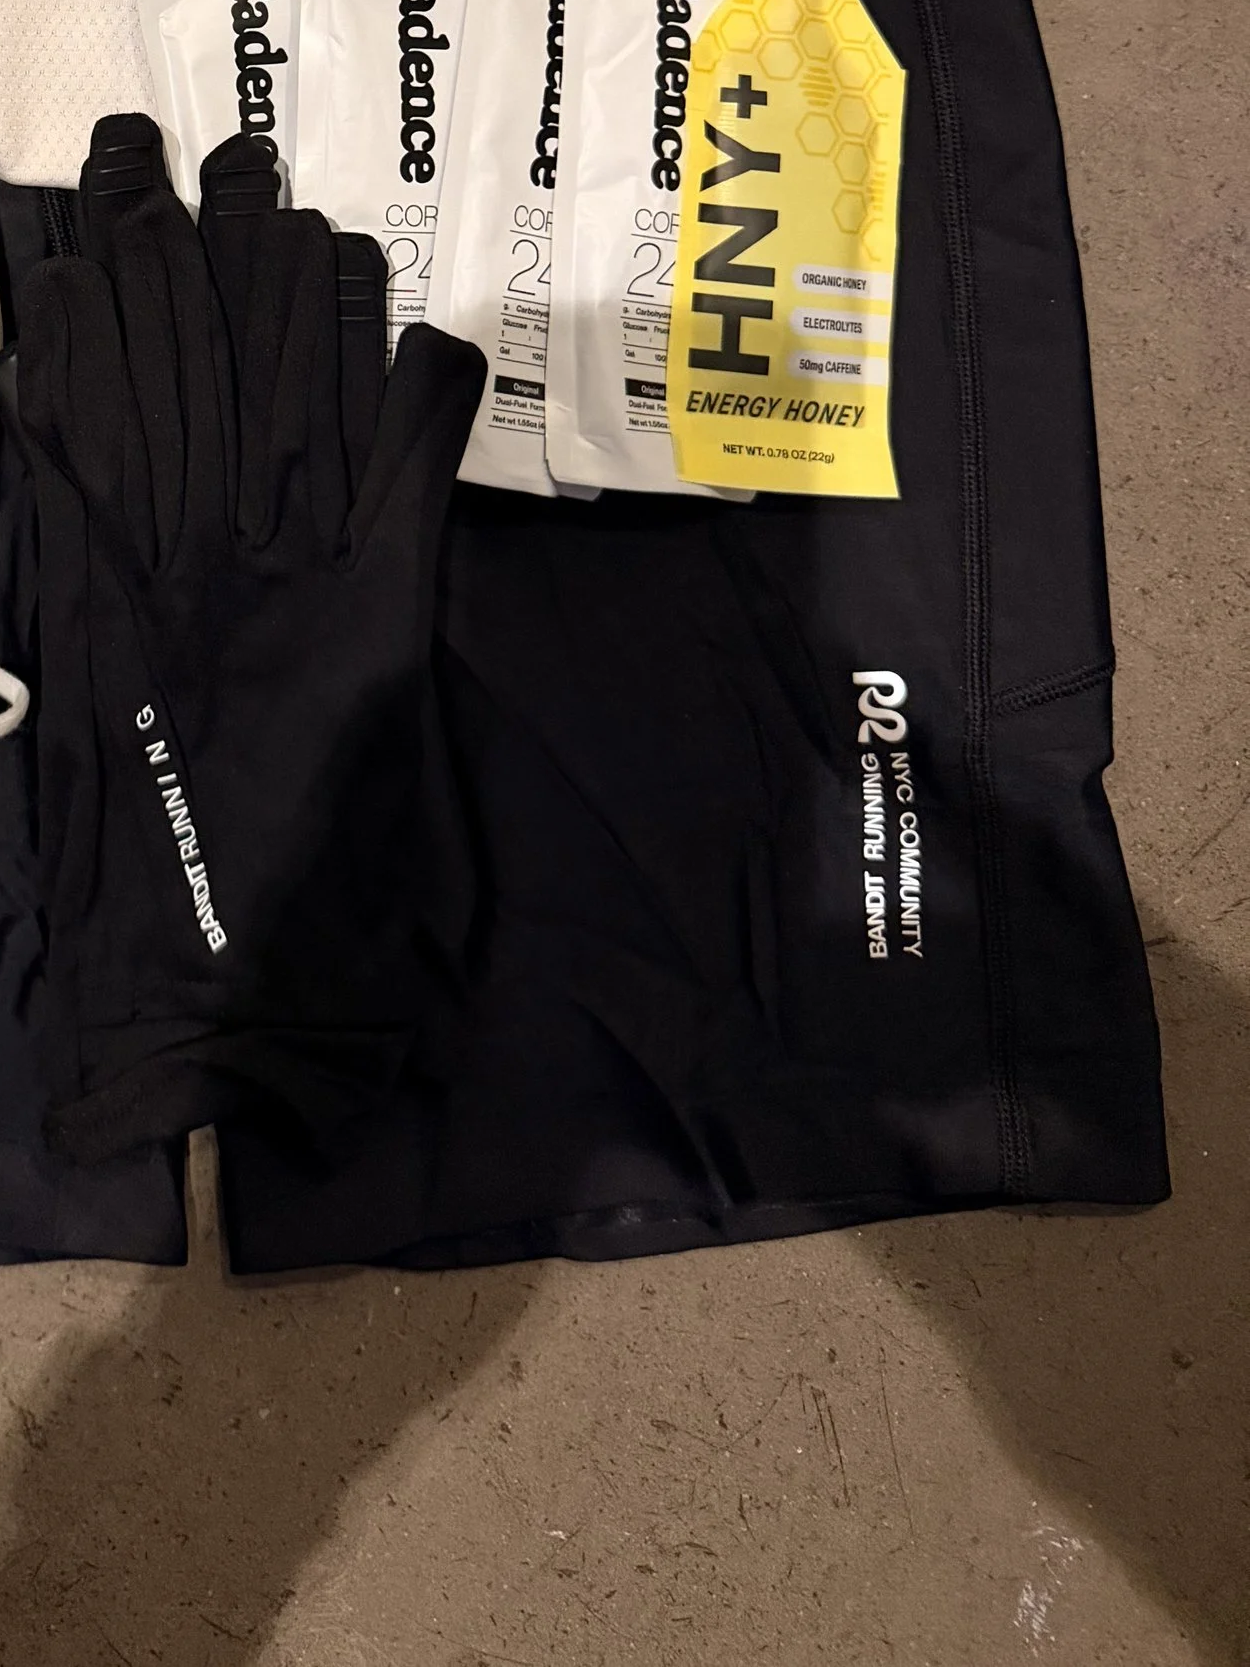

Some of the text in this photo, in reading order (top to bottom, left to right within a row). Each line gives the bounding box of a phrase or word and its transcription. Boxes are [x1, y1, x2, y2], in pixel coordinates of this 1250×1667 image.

[688, 74, 781, 376] HNY+
[802, 273, 867, 290] ORGANIC HONEY
[803, 317, 863, 334] ELECTROLYTES
[799, 359, 862, 375] 50mg CAFFEINE
[686, 390, 865, 428] ENERGY HONEY
[723, 443, 835, 464] NET WT. 0.78 OZ (22g)
[861, 752, 888, 959] BANDIT RUNNING
[890, 752, 924, 958] NYC COMMUNITY
[184, 862, 229, 955] BANDIT
